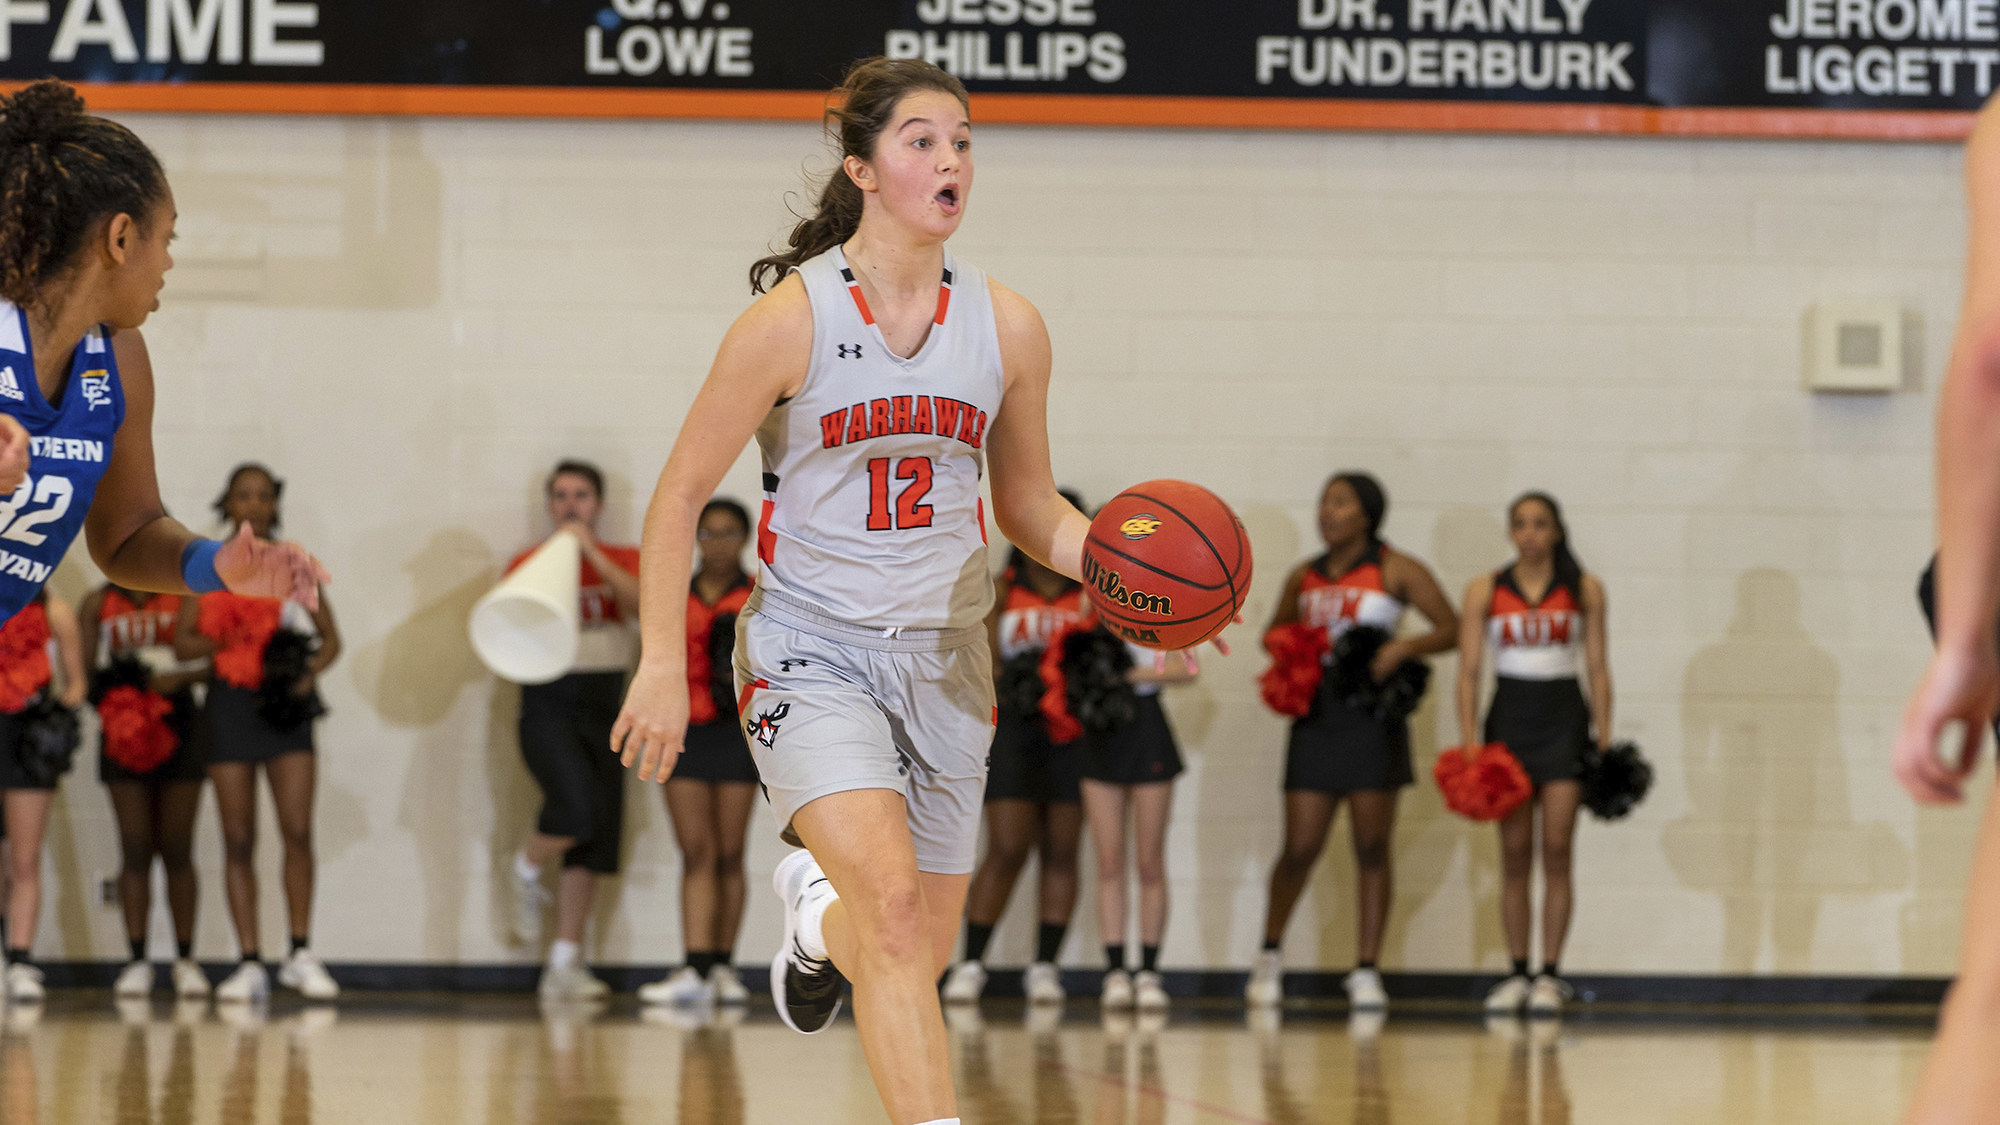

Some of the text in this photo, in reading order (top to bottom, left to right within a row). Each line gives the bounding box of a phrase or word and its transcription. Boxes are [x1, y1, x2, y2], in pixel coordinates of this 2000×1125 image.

[1297, 0, 1590, 34] DR. HANLY
[1768, 0, 2000, 42] JEROME
[584, 25, 754, 77] LOWE
[884, 29, 1128, 83] PHILLIPS
[1256, 35, 1635, 91] FUNDERBURK
[1764, 44, 2000, 97] LIGGETT
[820, 395, 987, 449] WARHAWKS
[866, 456, 934, 531] 12
[1083, 547, 1172, 617] Wilson
[1500, 609, 1571, 648] AUM
